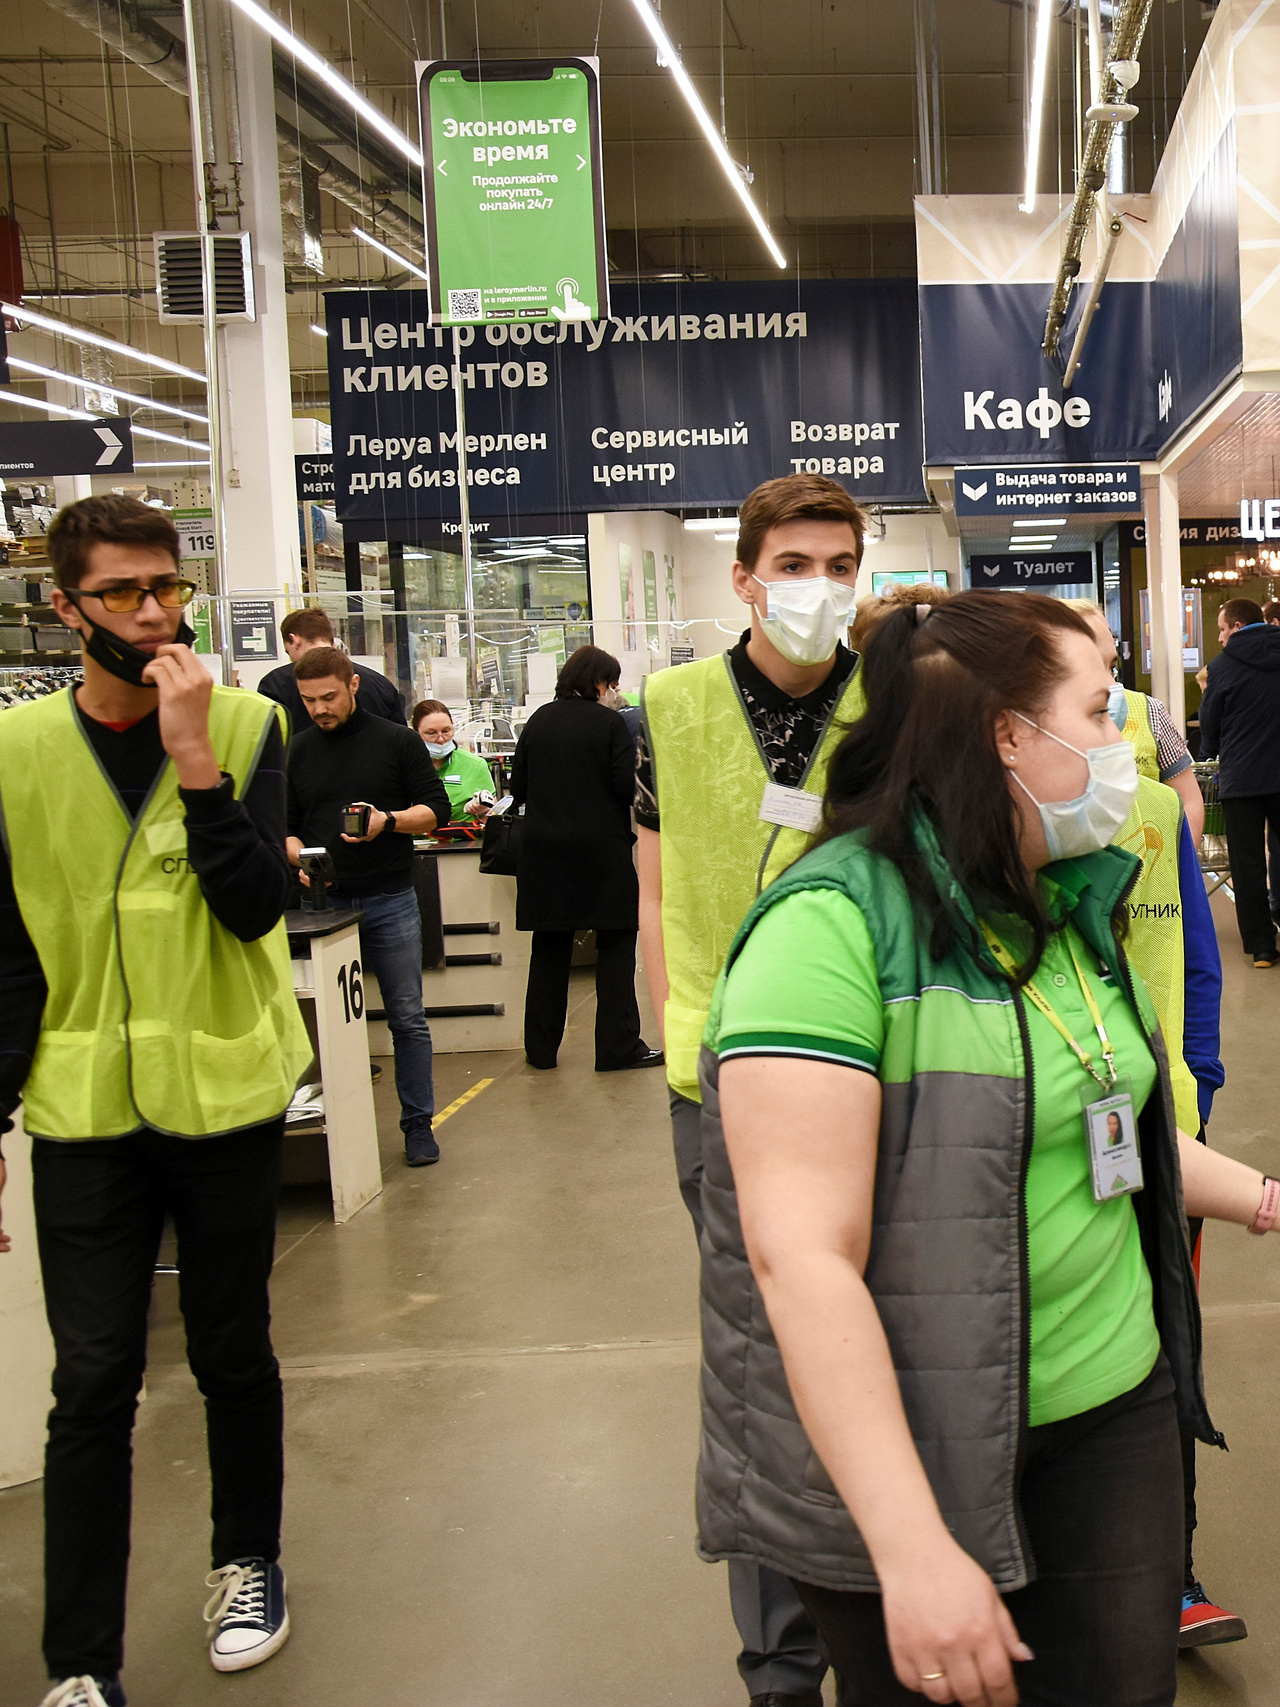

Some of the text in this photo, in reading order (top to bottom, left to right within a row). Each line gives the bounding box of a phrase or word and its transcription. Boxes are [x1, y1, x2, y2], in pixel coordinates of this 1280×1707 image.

[442, 117, 577, 138] Экономьте
[473, 144, 549, 166] время
[472, 172, 559, 187] Продолжайте
[486, 187, 543, 199] покупать
[479, 198, 554, 211] онлайн 24/7
[494, 286, 547, 294] leroymerlin.ru
[497, 295, 547, 304] приложении
[341, 312, 808, 357] Центр обслуживания
[343, 361, 549, 393] клиентов
[963, 387, 1091, 439] Кафе
[591, 422, 749, 453] Сервисный
[790, 420, 900, 446] Возврат
[347, 431, 547, 460] Леруа Мерлен
[593, 460, 676, 487] центр
[790, 455, 885, 479] товара
[348, 464, 521, 495] для бизнеса
[995, 472, 1127, 488] Выдача товара и
[996, 491, 1137, 507] интернет заказов
[441, 521, 490, 534] Кредит
[1013, 561, 1075, 577] Туалет
[1131, 903, 1181, 918] УТНИК
